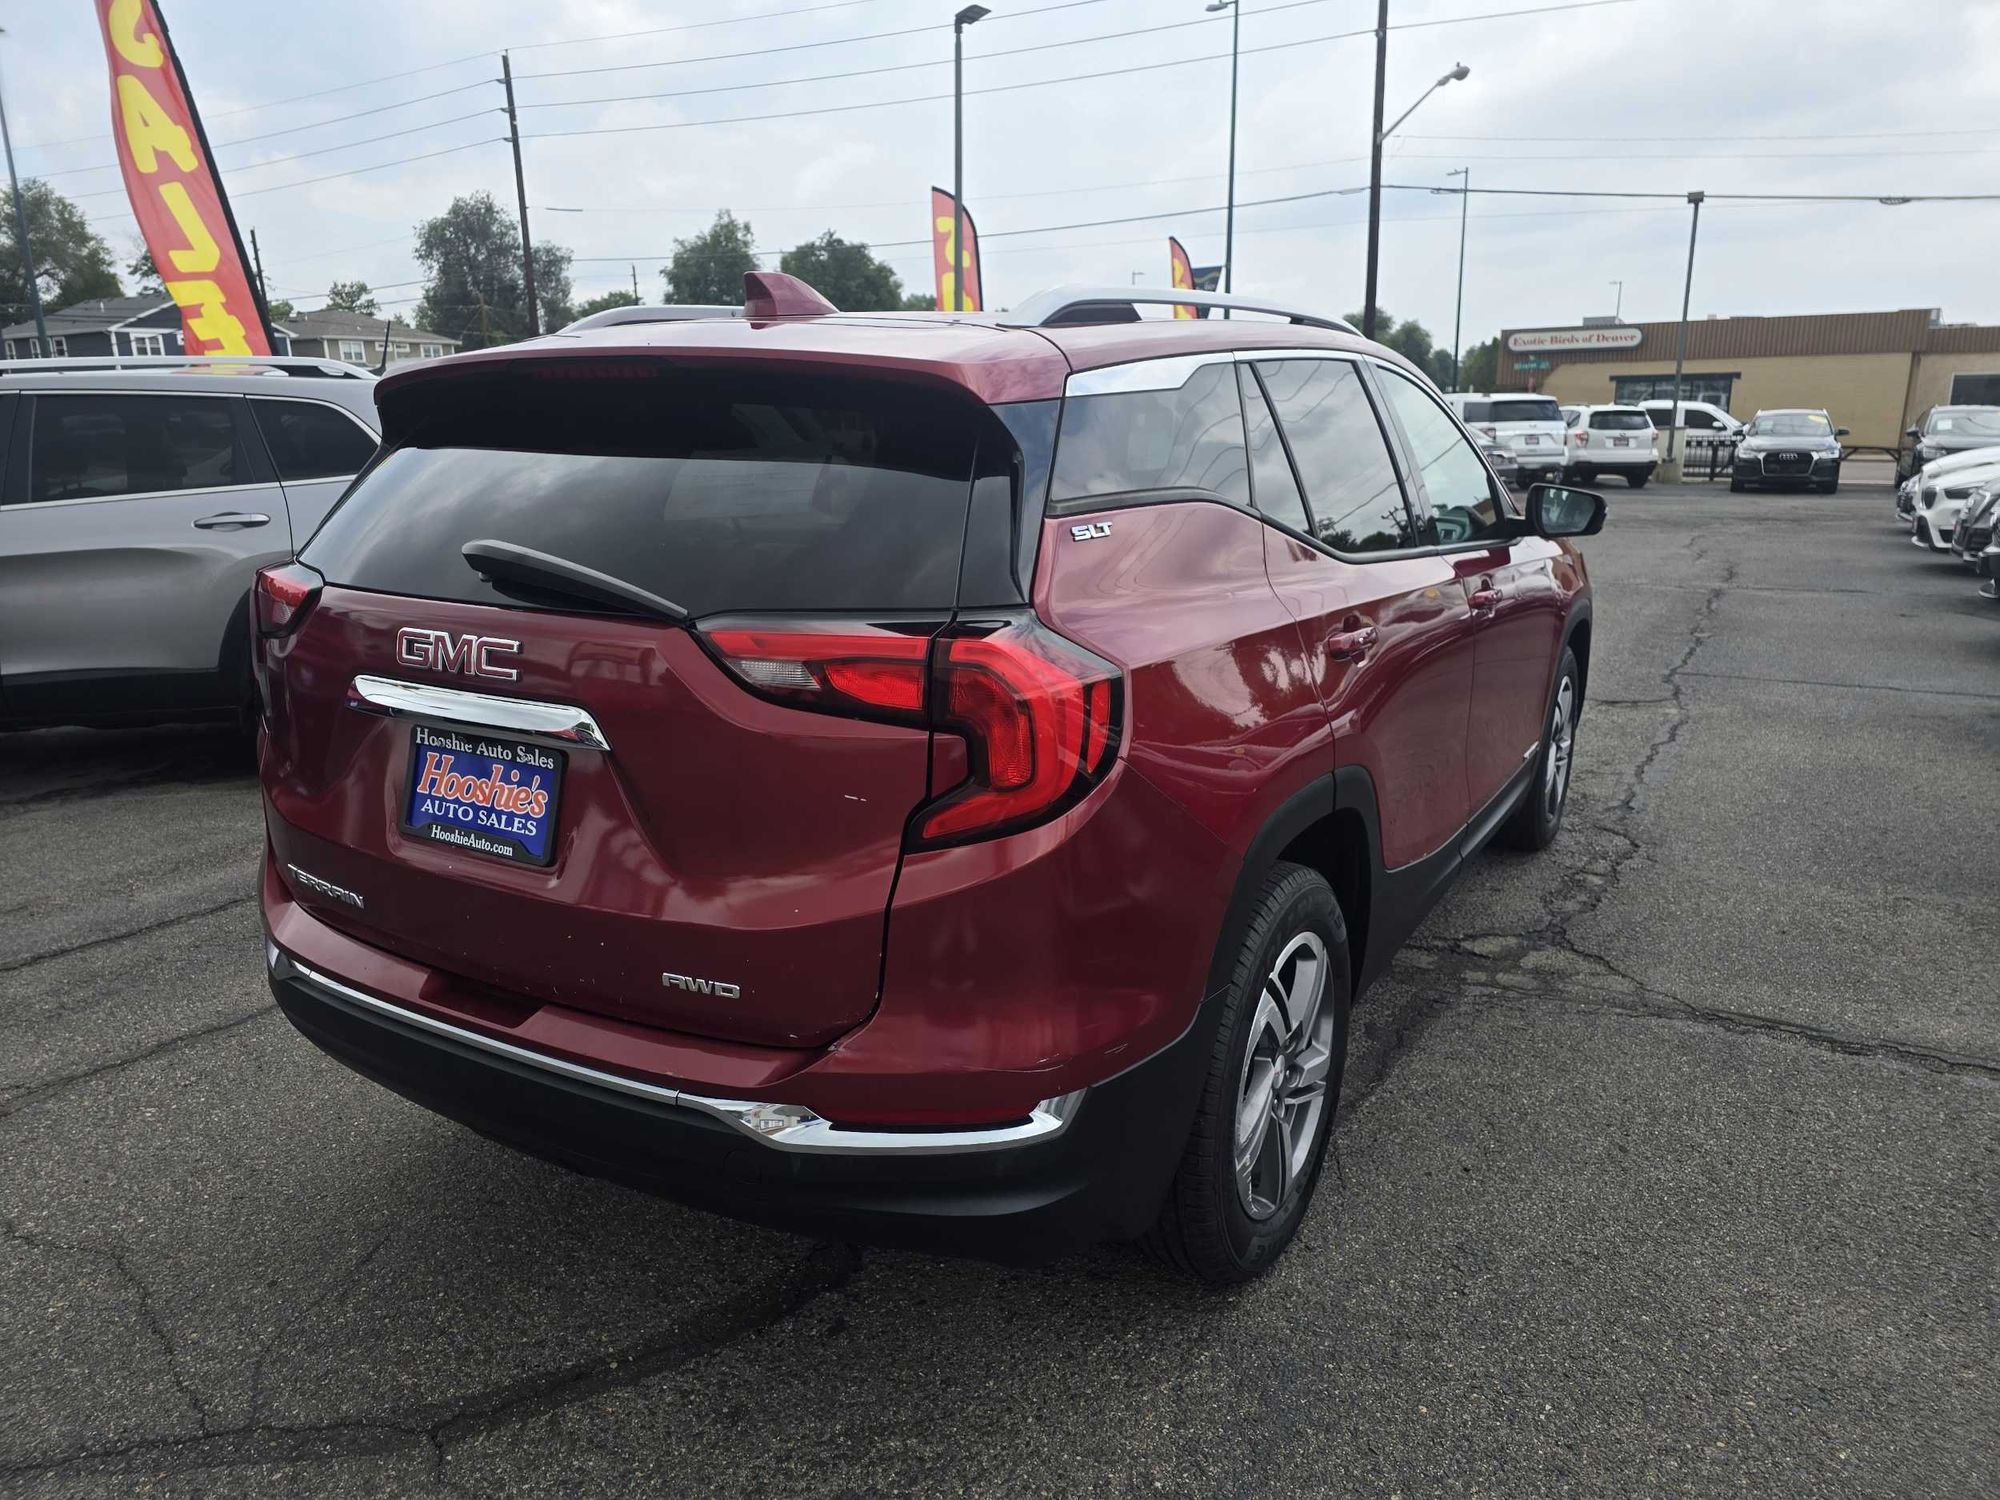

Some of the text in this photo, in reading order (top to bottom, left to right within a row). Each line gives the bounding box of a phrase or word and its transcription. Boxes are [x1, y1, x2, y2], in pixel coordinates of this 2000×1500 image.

[1513, 333, 1637, 347] Exotic Birds of Denver
[1070, 521, 1113, 542] SLT
[396, 626, 520, 681] GMC
[416, 727, 554, 769] Hooshie Auto Sales
[417, 752, 549, 818] Hooshie's
[421, 799, 537, 836] AUTO SALES
[430, 824, 513, 857] HooshieAuto.com
[287, 863, 365, 910] TERRAIN
[661, 972, 741, 999] AWD
